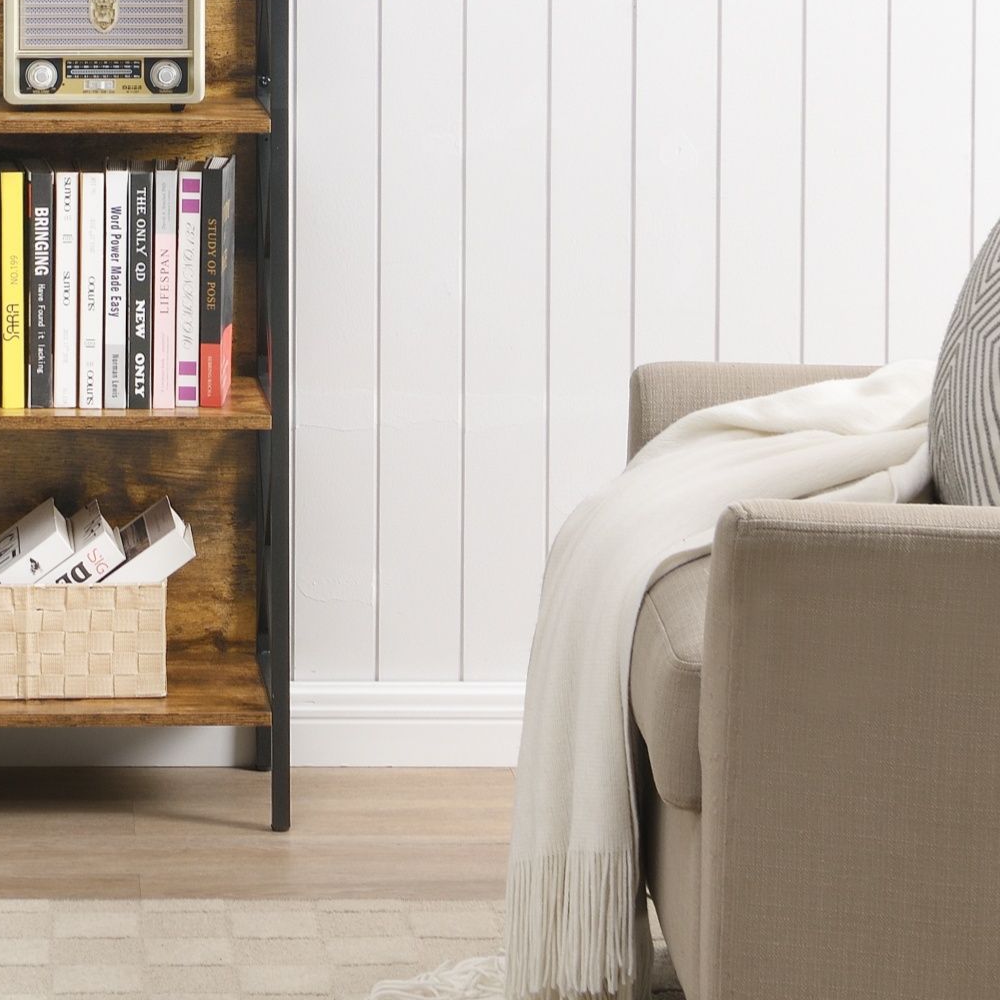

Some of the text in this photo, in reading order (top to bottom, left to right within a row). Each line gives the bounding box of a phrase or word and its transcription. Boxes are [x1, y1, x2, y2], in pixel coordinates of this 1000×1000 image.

[34, 207, 50, 276] BRINGING
[108, 206, 122, 318] Word Power Made Easy
[160, 248, 170, 314] LIFESPAN
[206, 218, 217, 311] STUDY OF POSE
[36, 283, 46, 374] Have Found it lacking
[134, 187, 147, 398] THE ONLY QD NEW ONLY
